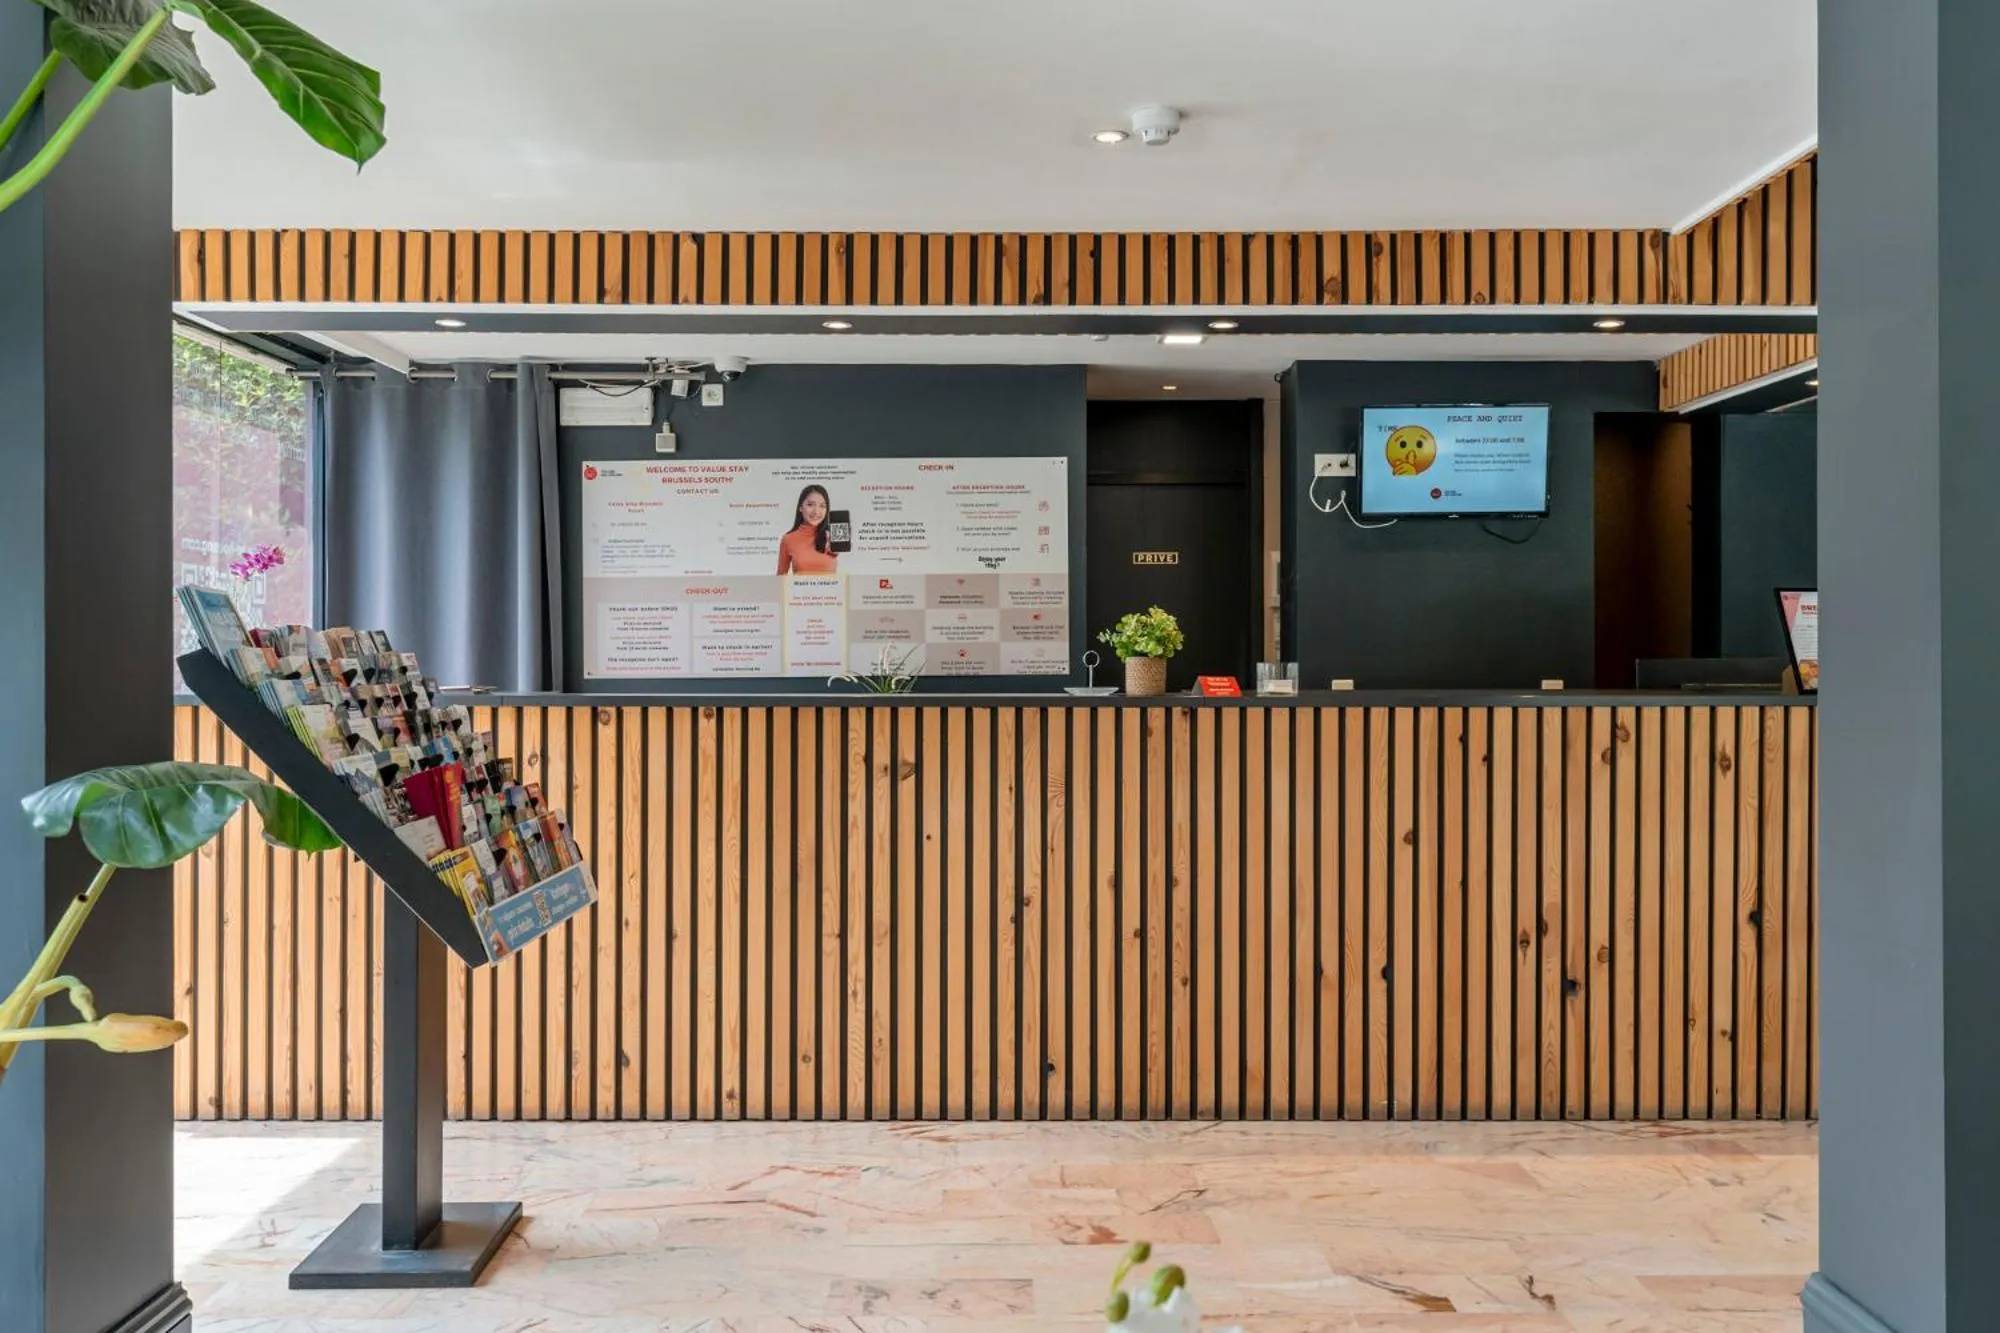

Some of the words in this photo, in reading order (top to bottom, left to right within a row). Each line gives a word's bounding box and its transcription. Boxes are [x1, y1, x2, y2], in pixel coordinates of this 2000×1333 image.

[646, 465, 686, 473] WELCOME
[687, 465, 699, 473] TO
[700, 465, 726, 473] VALUE
[728, 465, 749, 473] STAY
[1138, 554, 1174, 563] PRIVE
